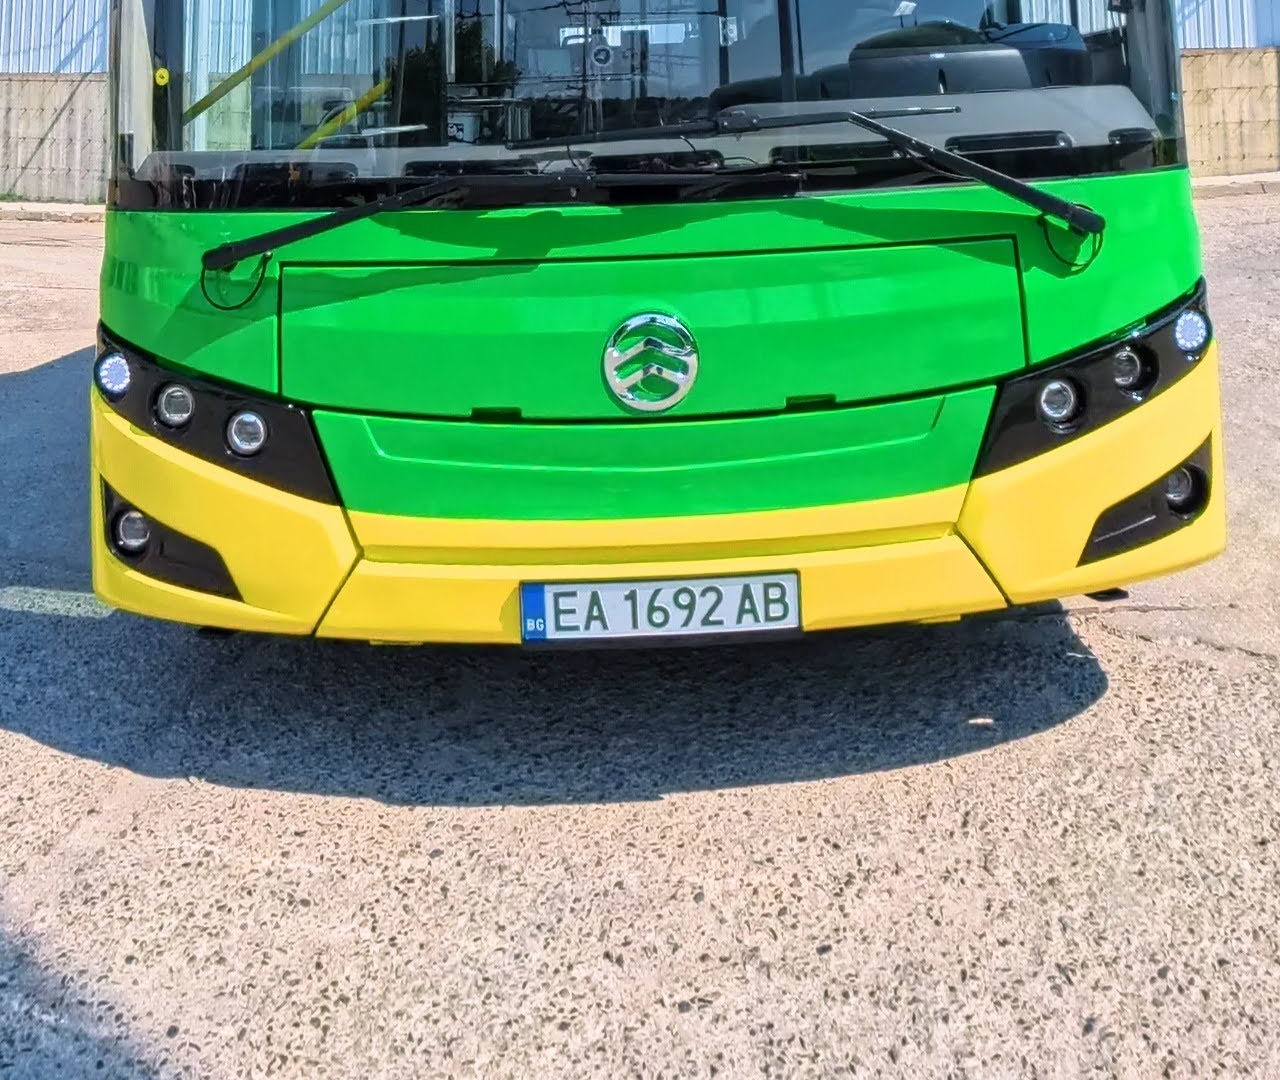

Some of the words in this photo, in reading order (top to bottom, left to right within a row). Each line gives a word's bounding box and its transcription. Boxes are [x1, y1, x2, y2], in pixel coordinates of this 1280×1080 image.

[552, 590, 609, 632] EA
[624, 584, 725, 630] 1692
[735, 581, 789, 625] AB
[526, 618, 545, 632] BG
